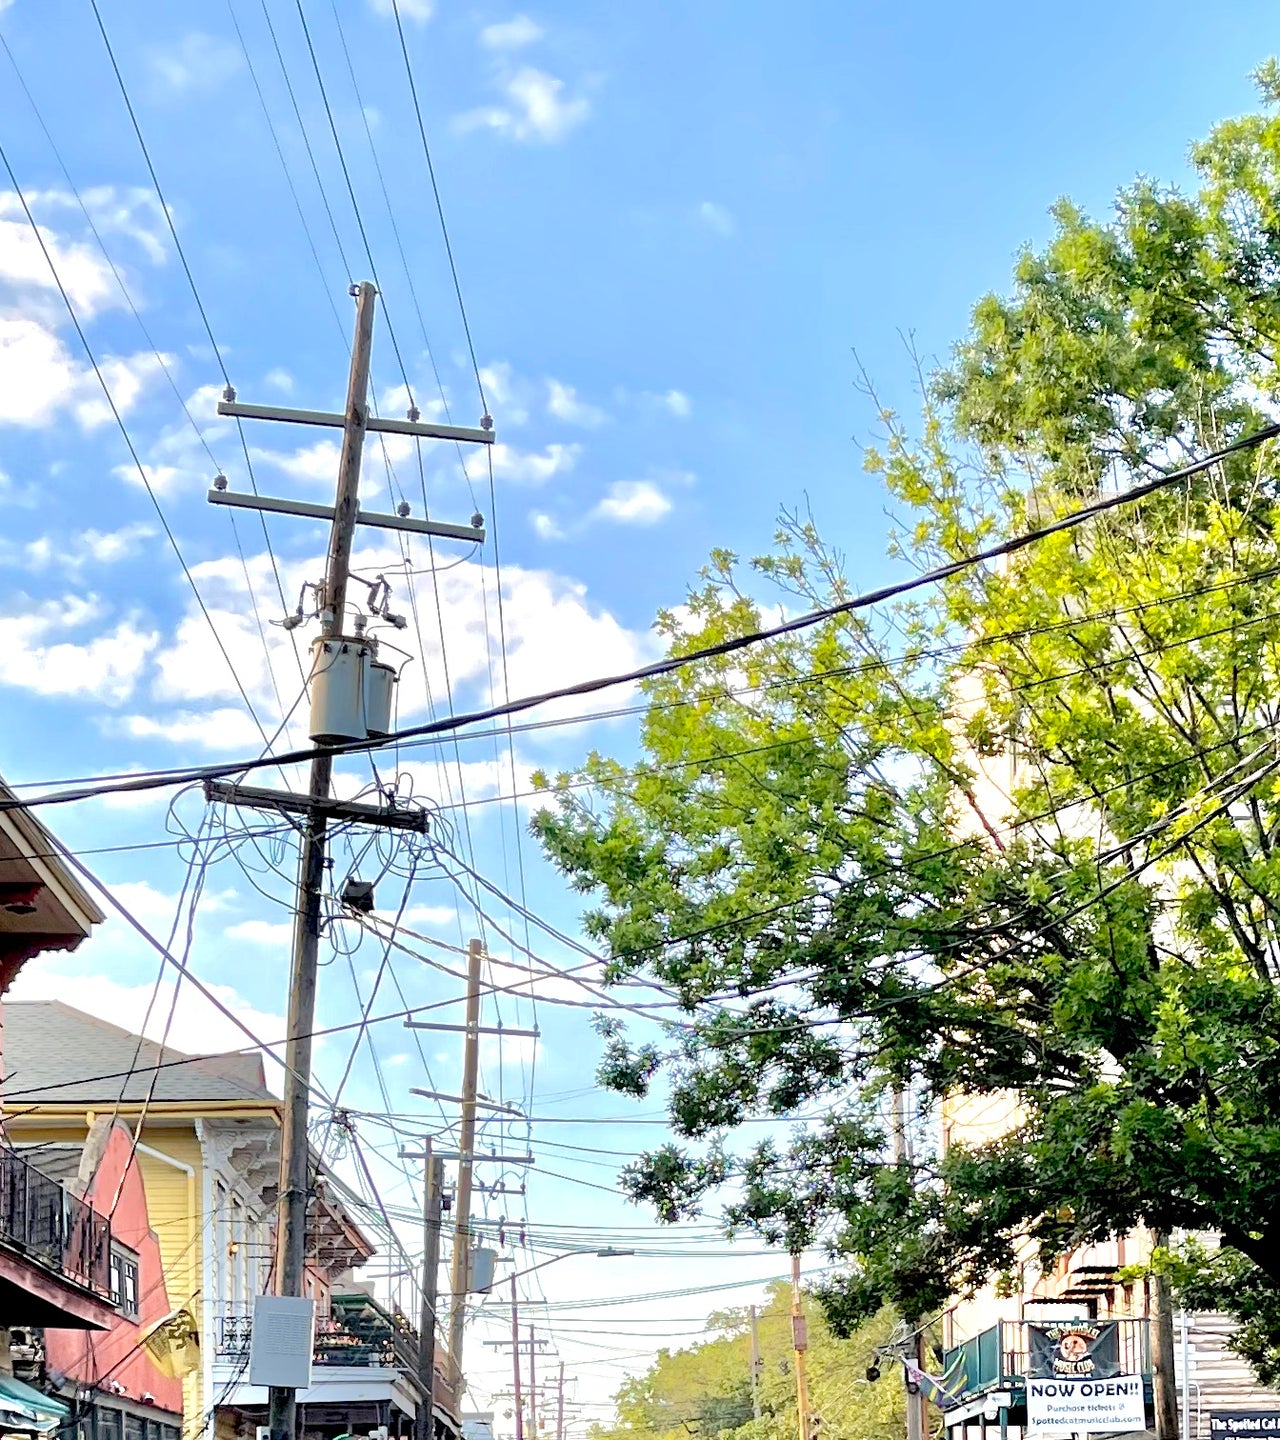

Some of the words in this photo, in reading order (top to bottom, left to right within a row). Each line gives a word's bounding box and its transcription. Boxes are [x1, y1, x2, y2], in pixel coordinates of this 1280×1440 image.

[1031, 1384, 1075, 1398] NOW
[1080, 1382, 1139, 1397] OPEN!!
[1211, 1418, 1227, 1430] The
[1228, 1418, 1261, 1432] Spotted
[1262, 1418, 1276, 1430] Cat
